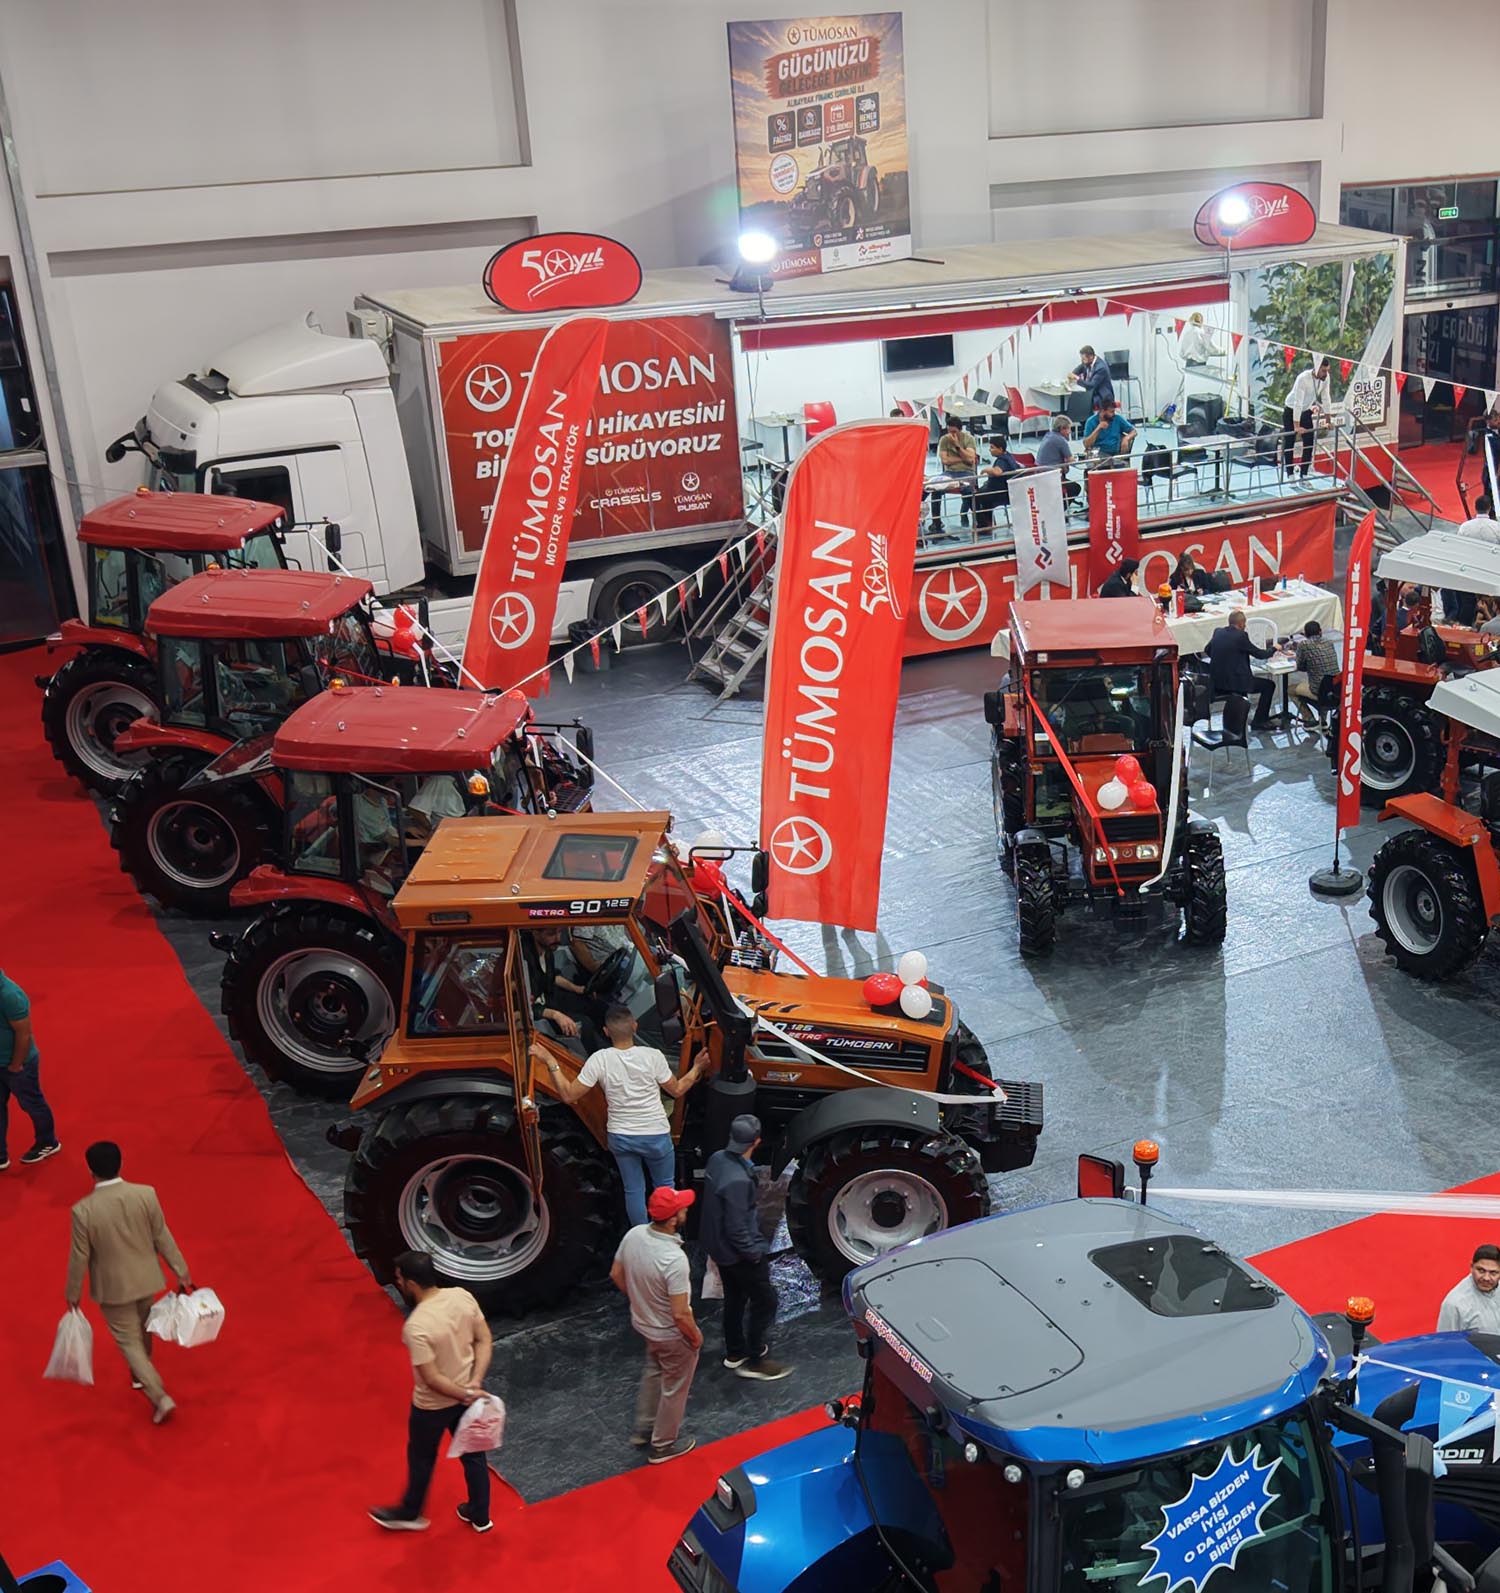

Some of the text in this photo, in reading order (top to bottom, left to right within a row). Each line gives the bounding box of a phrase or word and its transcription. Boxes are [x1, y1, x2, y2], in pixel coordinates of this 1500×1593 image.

[803, 26, 858, 41] TÜMOSAN
[778, 40, 870, 80] GÜCÜNÜZÜ
[598, 399, 726, 437] HİKAYESİNİ
[585, 433, 722, 467] SÜRÜYORUZ
[510, 390, 568, 583] TÜMOSAN
[544, 514, 564, 567] MOTOR
[557, 424, 581, 493] TRAKTÖR
[590, 491, 662, 509] CRASSUS
[677, 502, 711, 512] PUSAT
[1027, 487, 1041, 546] albayrak
[1105, 481, 1116, 540] albayrak
[782, 520, 857, 800] TÜMOSAN
[529, 898, 630, 917] RETRO 90 125
[826, 1037, 894, 1050] TÜMOSAN
[1166, 1470, 1250, 1540] VARSA BİZDEN
[1200, 1504, 1229, 1533] İYİSİ
[1184, 1501, 1257, 1563] O DA BİZDEN
[1209, 1529, 1244, 1563] BİRİSİ
